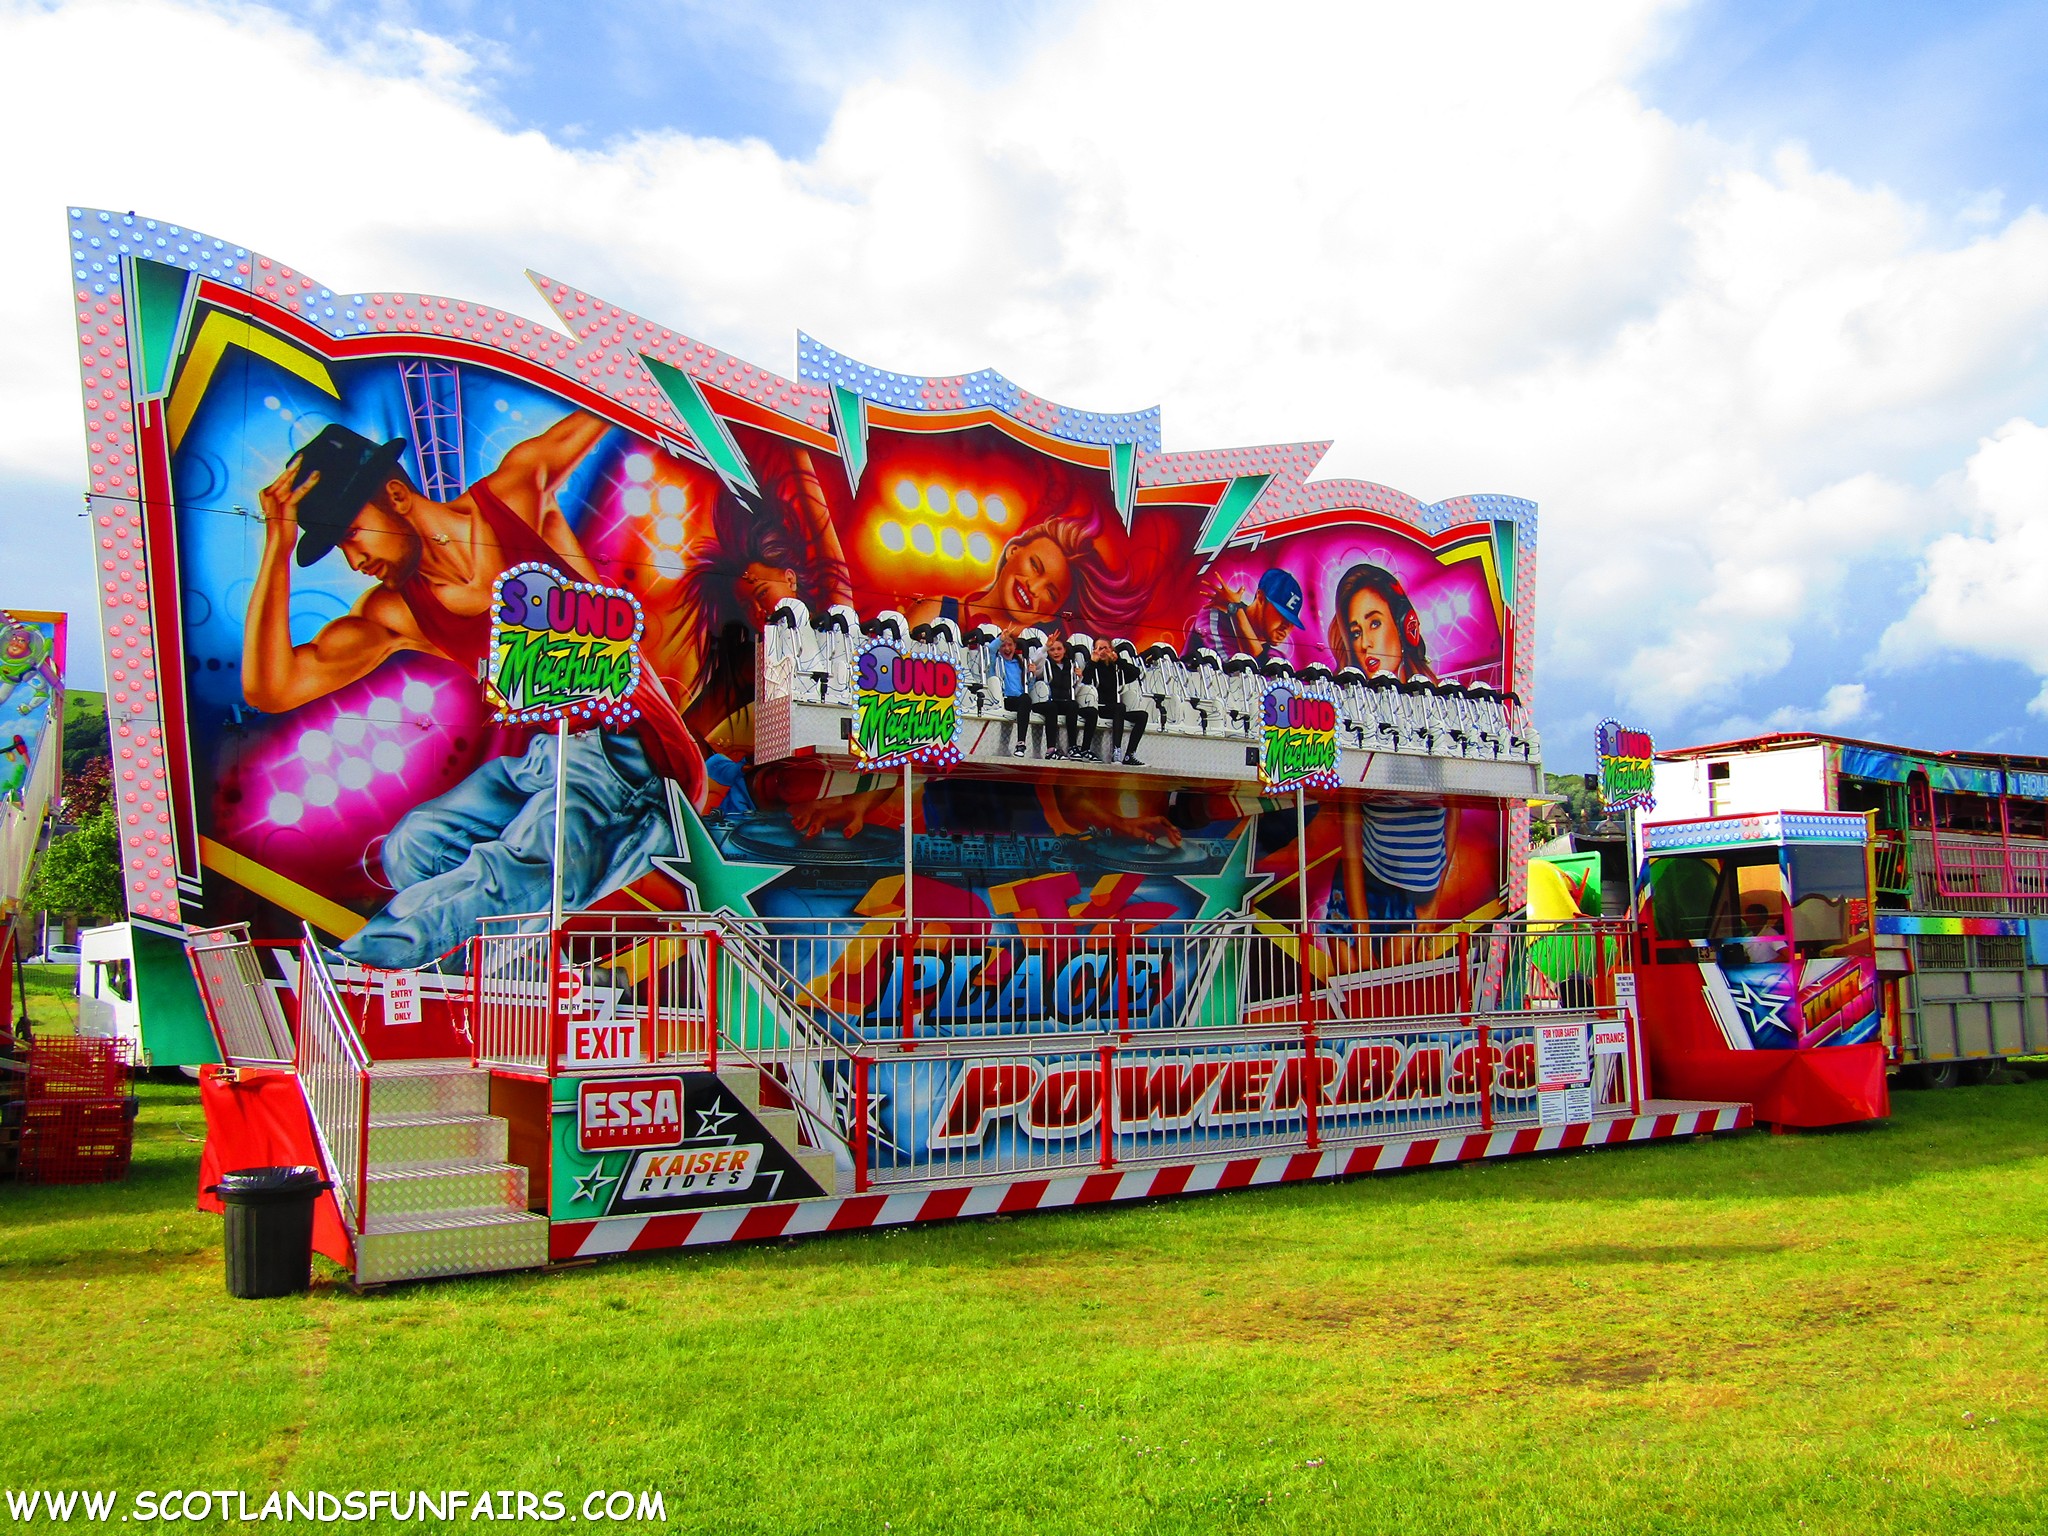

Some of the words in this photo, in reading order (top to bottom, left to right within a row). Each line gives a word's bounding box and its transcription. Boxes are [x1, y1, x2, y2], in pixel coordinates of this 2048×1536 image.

[500, 571, 635, 641] SOUND
[498, 631, 631, 710] Machine
[857, 645, 956, 698] SOUND
[858, 694, 955, 758] Machine
[1263, 688, 1335, 731] SOUND
[1264, 729, 1335, 782] Machine
[1600, 723, 1651, 760] SOUND
[390, 989, 413, 998] ENTRY
[396, 978, 407, 986] NO
[858, 947, 1171, 1026] PLACE
[394, 1011, 412, 1021] ONLY
[395, 1000, 410, 1009] EXIT
[575, 1026, 635, 1060] EXIT
[1543, 1029, 1551, 1038] FOR
[1552, 1029, 1564, 1038] YOUR
[1564, 1027, 1580, 1037] SAFETY
[1595, 1032, 1625, 1044] ENTRANCE
[585, 1090, 678, 1128] ESSA
[927, 1037, 1538, 1149] POWERBASS
[585, 1125, 679, 1138] AIRBRUSH
[639, 1170, 742, 1192] RIDES
[645, 1150, 749, 1178] KAISER
